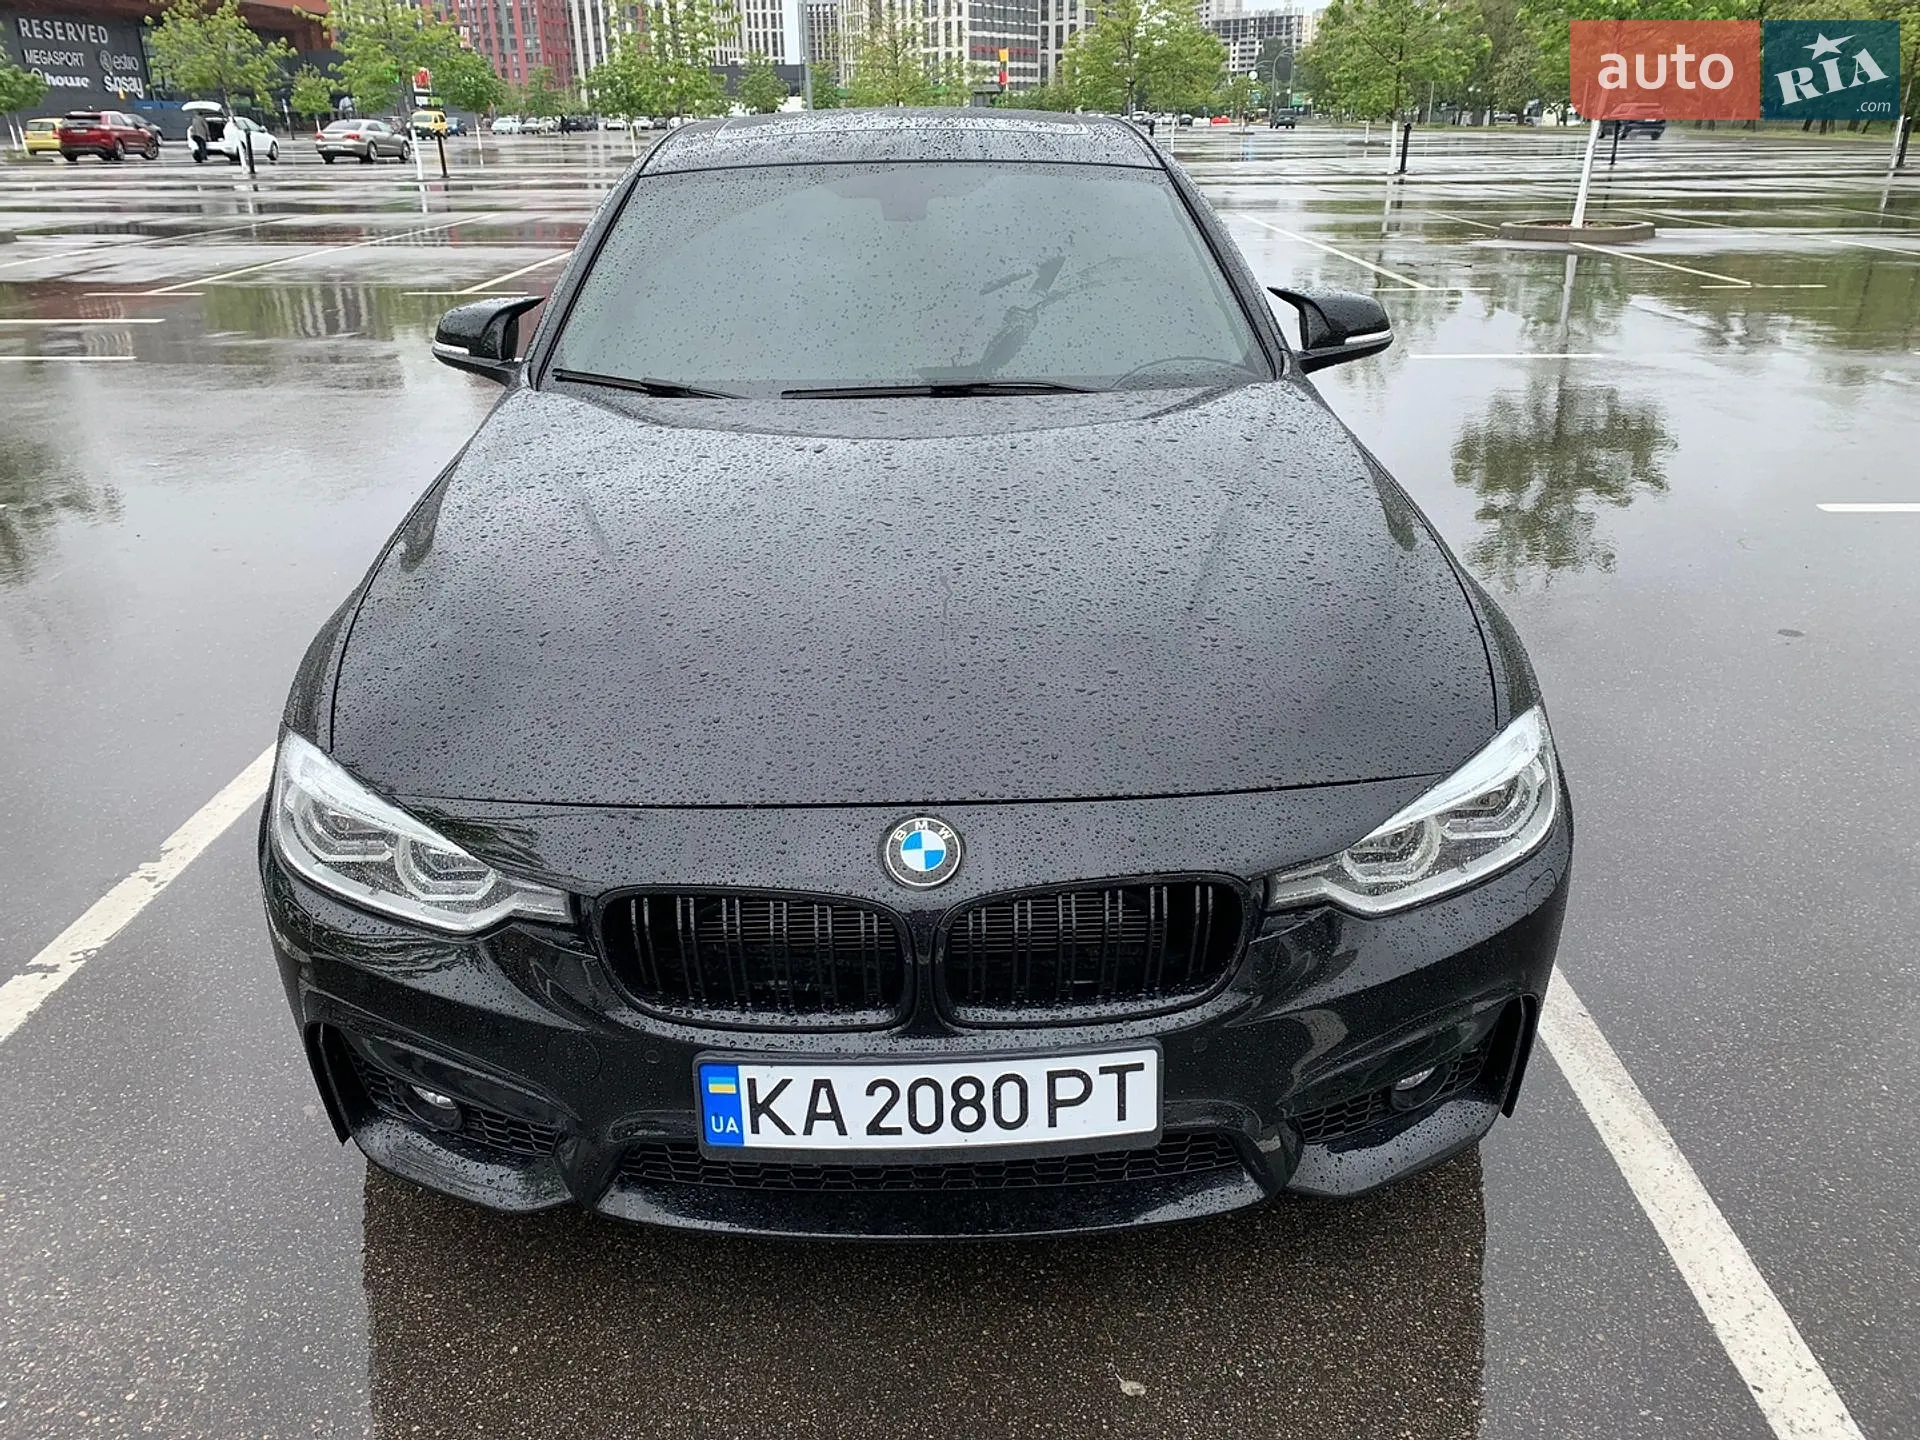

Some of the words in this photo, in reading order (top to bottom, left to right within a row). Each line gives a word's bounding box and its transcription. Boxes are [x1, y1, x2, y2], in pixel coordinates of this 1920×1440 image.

[18, 18, 108, 44] RESERVED
[24, 48, 85, 67] MEGASPORT
[893, 820, 953, 842] BMW
[747, 1077, 848, 1137] KA
[865, 1073, 1029, 1137] 2080
[1046, 1062, 1145, 1128] PT
[710, 1115, 740, 1134] UA
